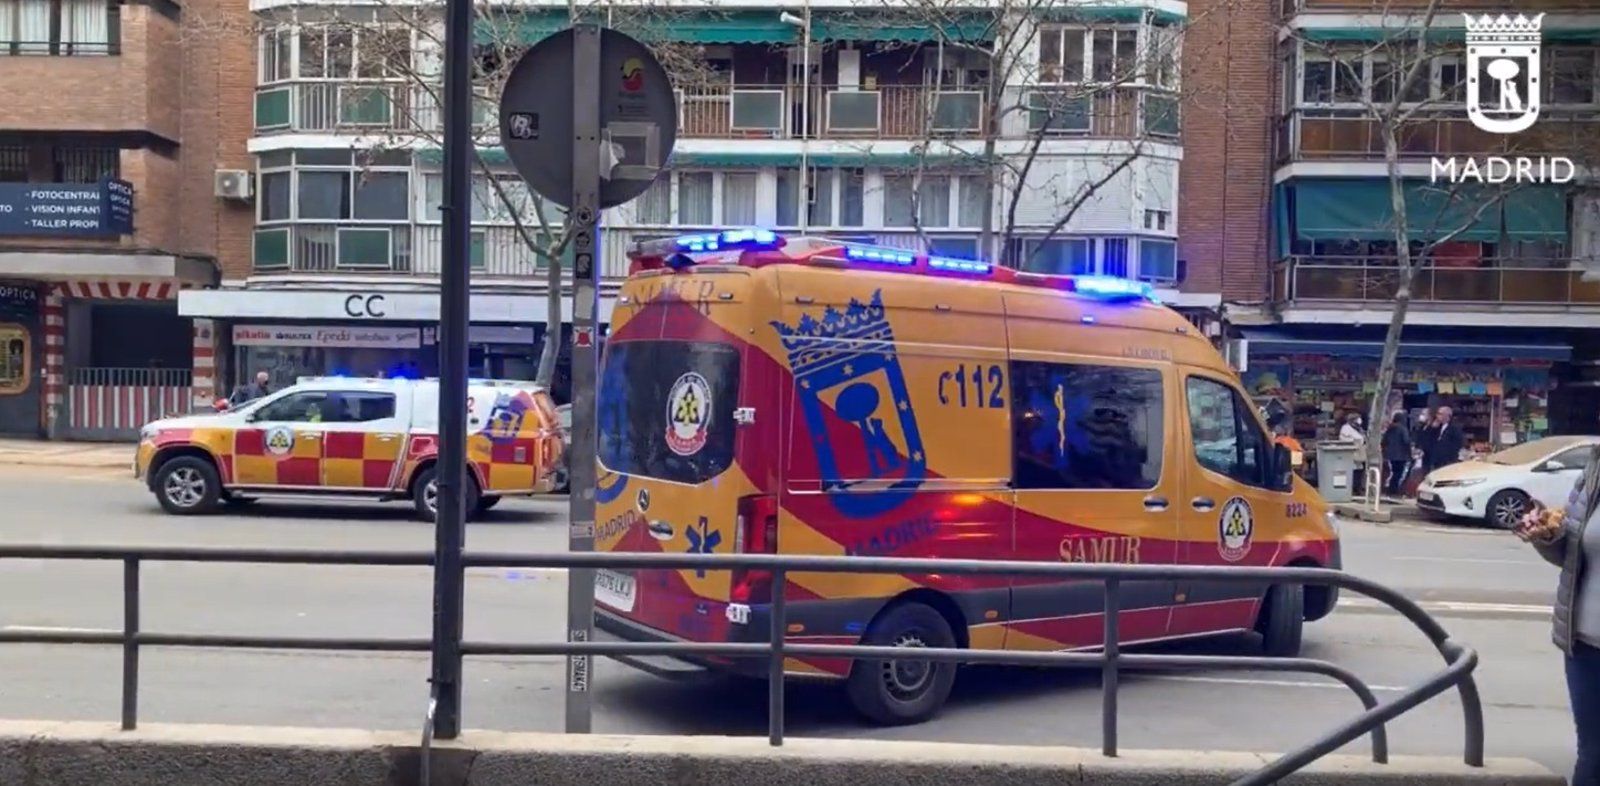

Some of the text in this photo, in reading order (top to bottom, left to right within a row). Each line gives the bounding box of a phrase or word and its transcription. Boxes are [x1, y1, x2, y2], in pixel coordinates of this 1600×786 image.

[108, 181, 132, 195] OPTICA
[31, 205, 65, 213] VISION
[31, 219, 67, 227] TALLER
[0, 286, 37, 300] OPTICA
[345, 294, 386, 317] CC
[1059, 535, 1141, 564] SAMUR
